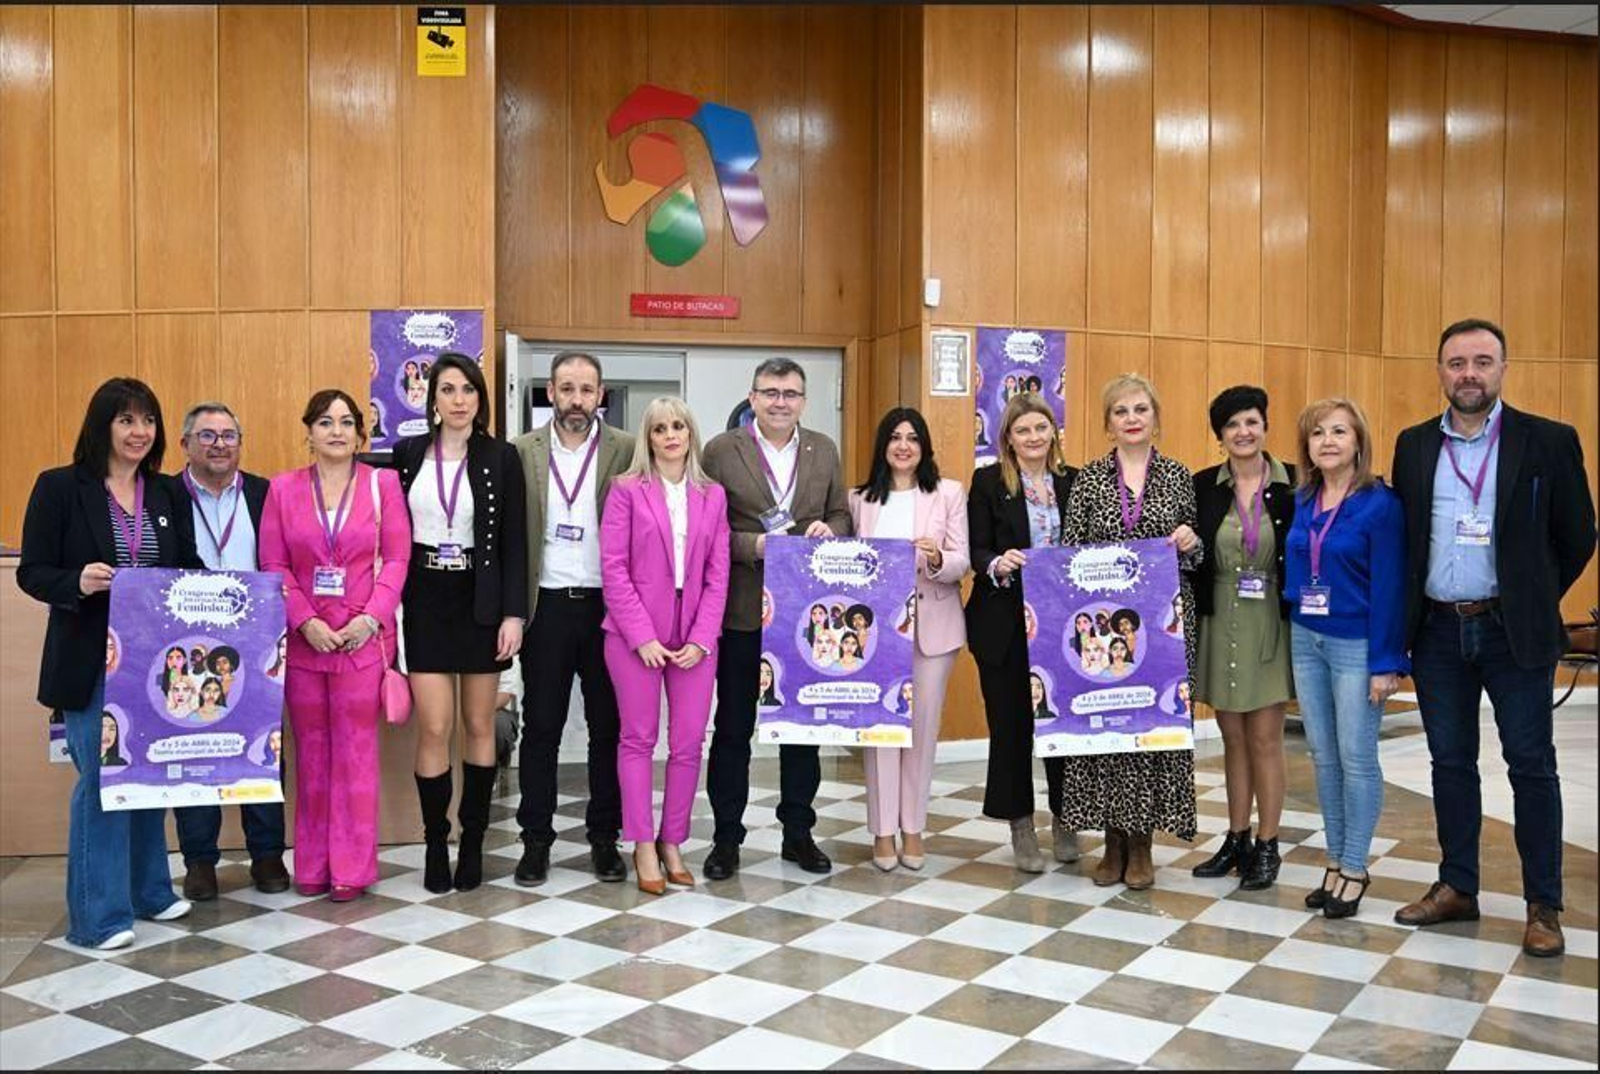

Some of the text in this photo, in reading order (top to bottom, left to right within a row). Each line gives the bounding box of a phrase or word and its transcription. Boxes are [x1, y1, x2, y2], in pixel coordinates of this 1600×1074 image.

[647, 300, 724, 311] PATIO DE BUTACAS
[178, 602, 232, 614] Feminista
